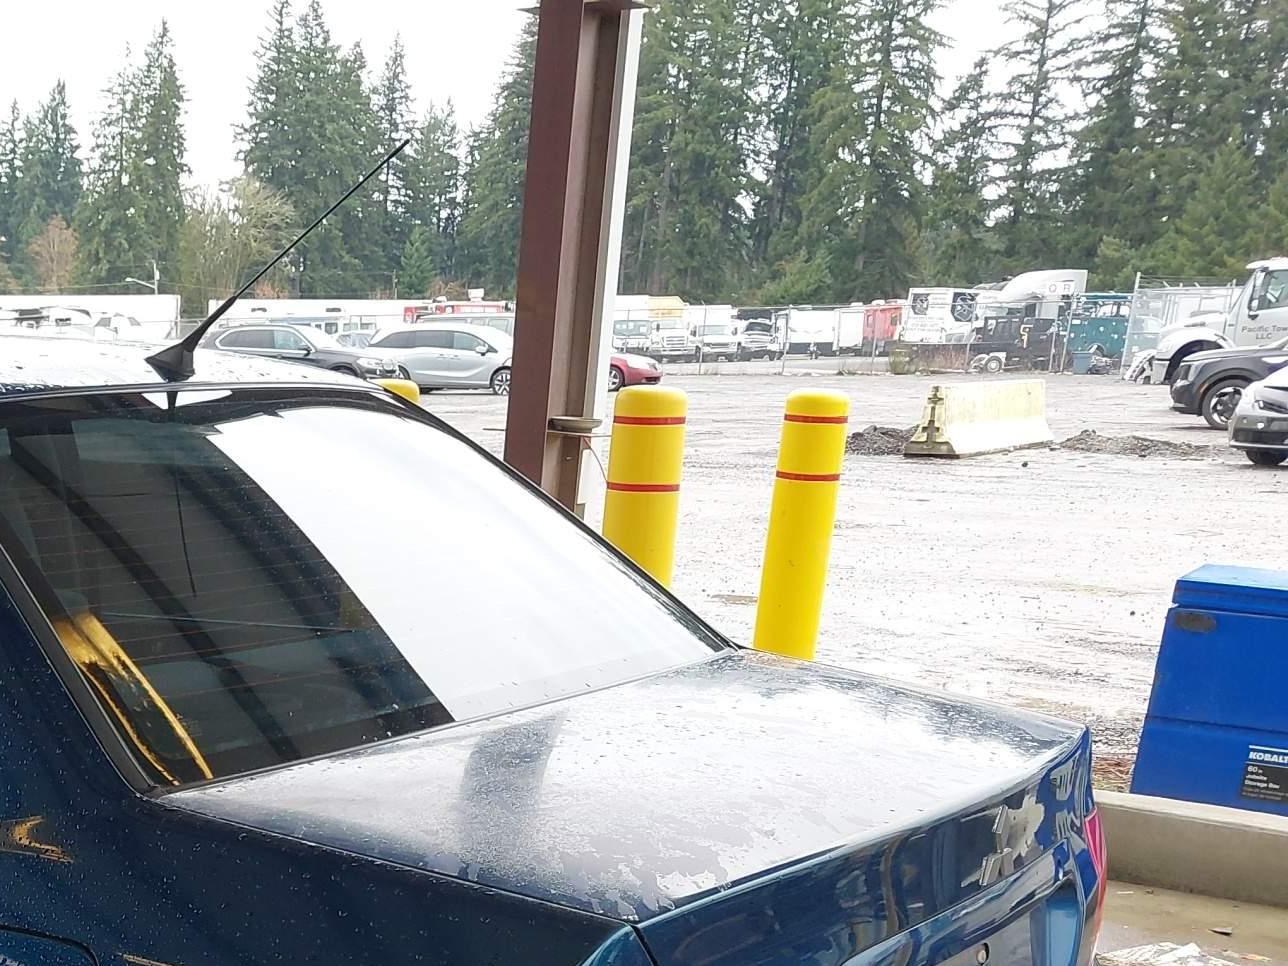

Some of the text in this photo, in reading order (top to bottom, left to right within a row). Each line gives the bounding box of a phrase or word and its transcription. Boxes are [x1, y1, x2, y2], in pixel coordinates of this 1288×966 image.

[1241, 325, 1270, 333] Pacific
[1255, 332, 1272, 340] LLC
[1248, 751, 1288, 763] KOBALT
[1247, 765, 1258, 773] 60
